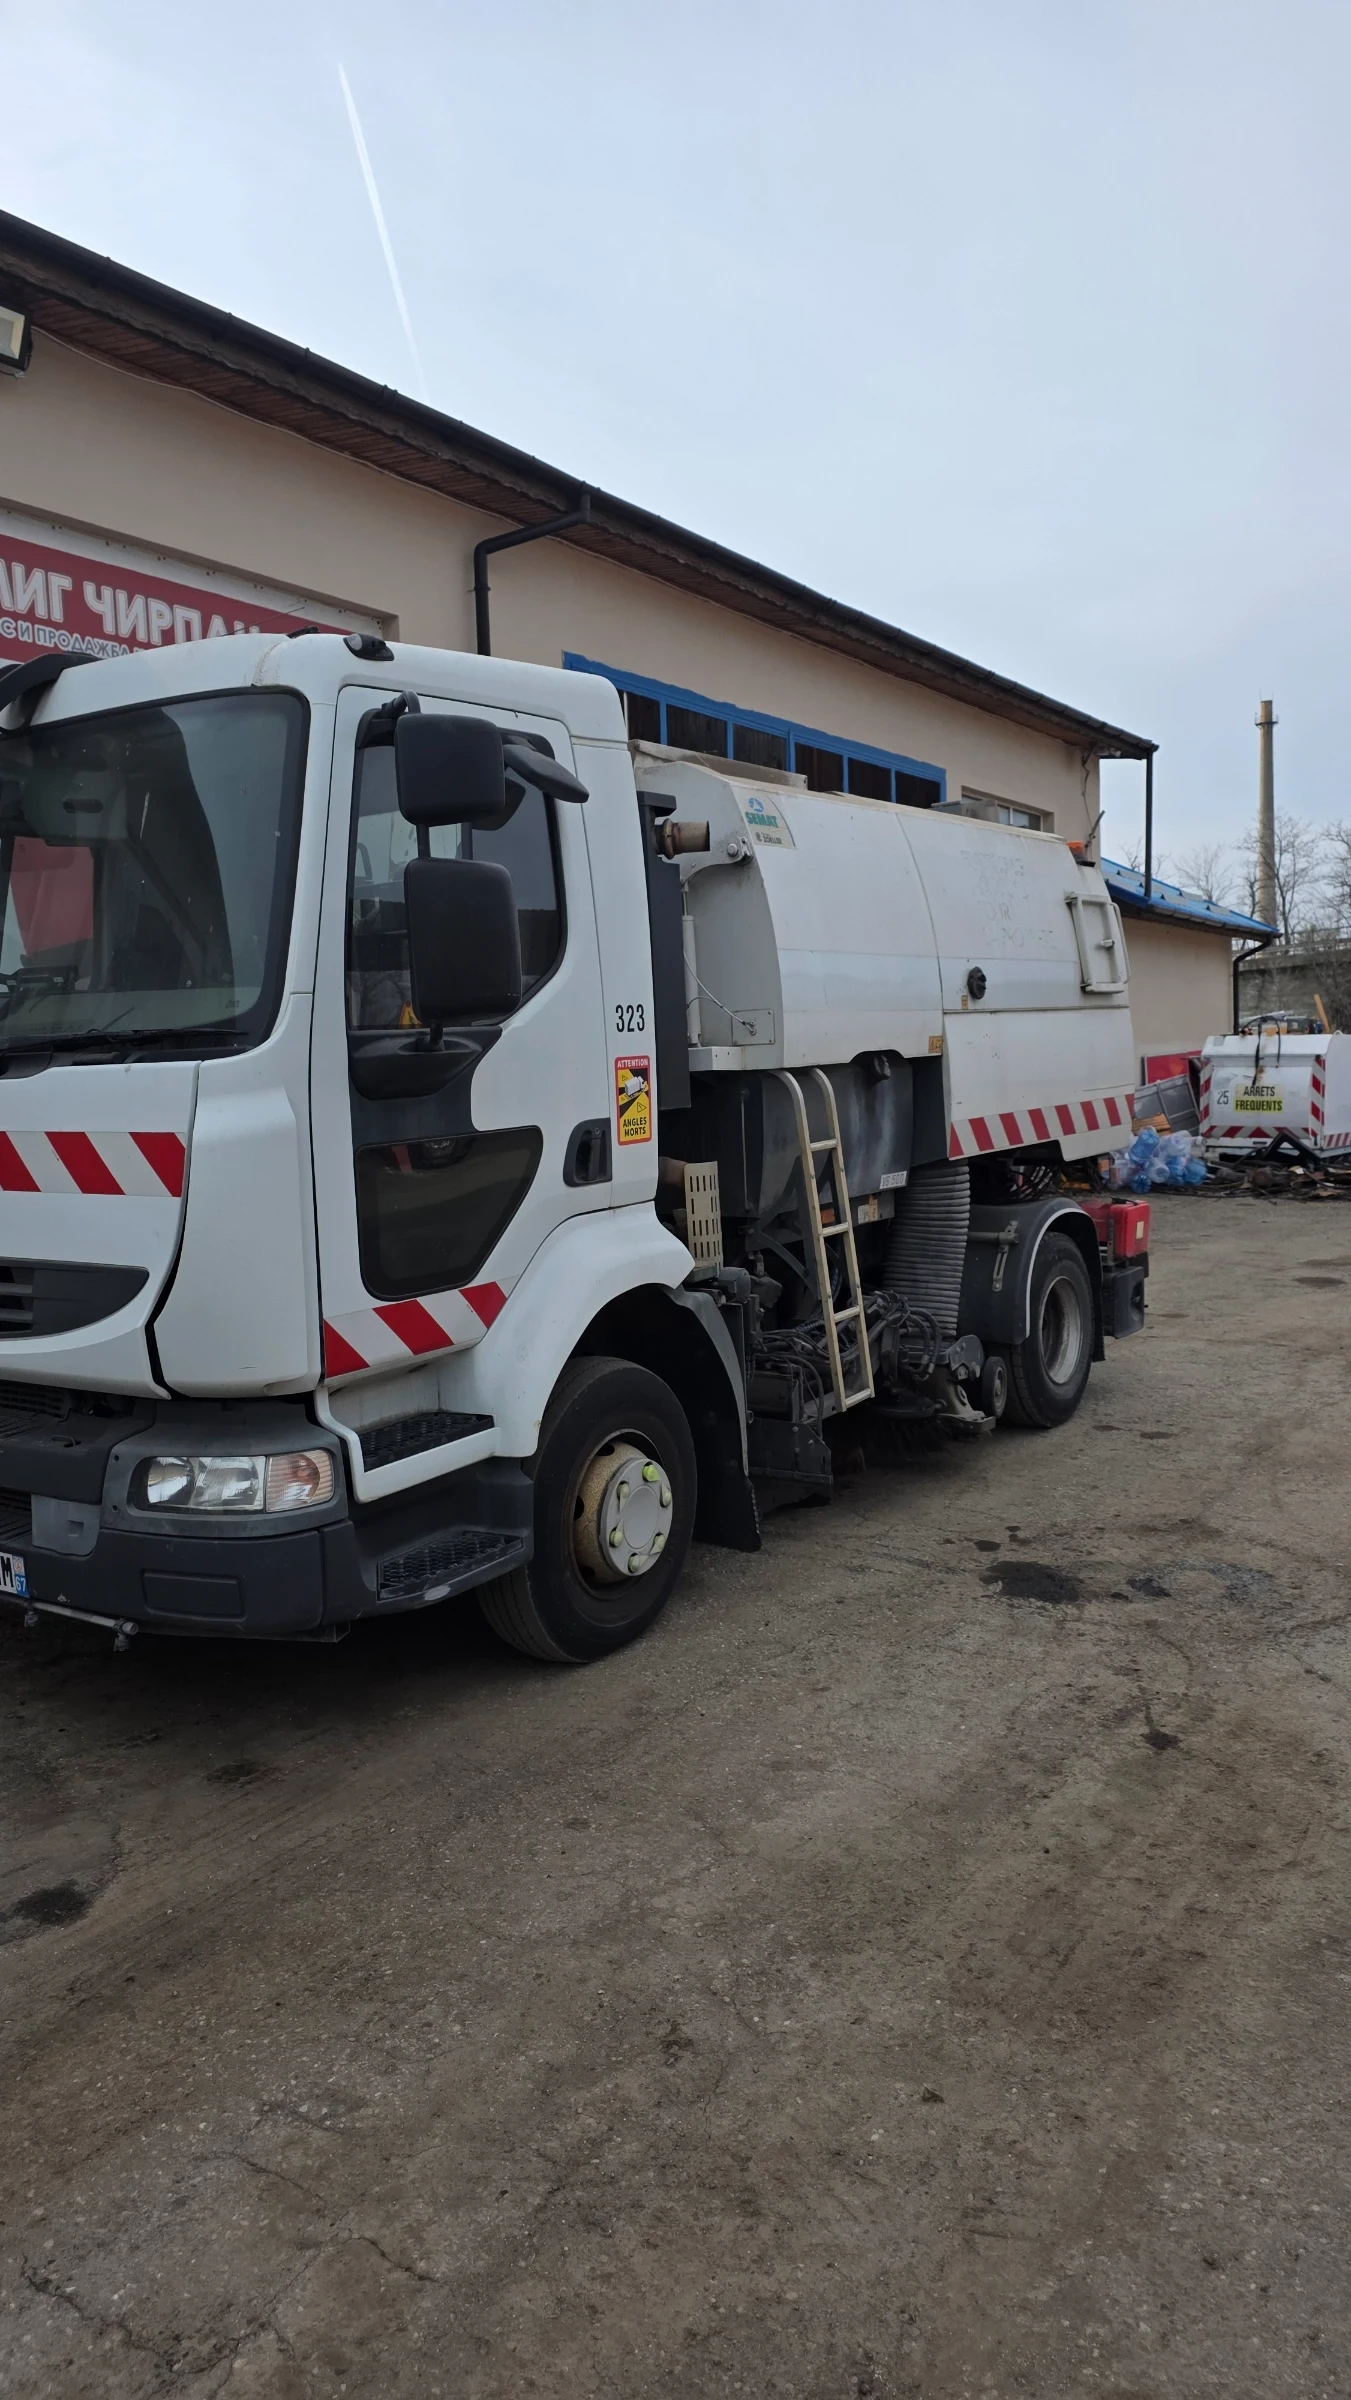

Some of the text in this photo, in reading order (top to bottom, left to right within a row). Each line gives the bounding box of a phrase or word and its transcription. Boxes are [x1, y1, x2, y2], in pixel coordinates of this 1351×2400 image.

[17, 620, 32, 643] И
[745, 811, 778, 828] SEMAT
[615, 1003, 645, 1033] 323
[617, 1058, 649, 1068] ATTENTION
[1217, 1090, 1230, 1105] 25
[1243, 1086, 1275, 1096] ARRETS
[1235, 1100, 1282, 1111] FREQUENTS
[622, 1116, 647, 1128] ANGLES
[624, 1127, 646, 1137] MORTS
[891, 1173, 904, 1185] 500
[0, 1555, 14, 1588] M
[16, 1576, 26, 1591] 67
